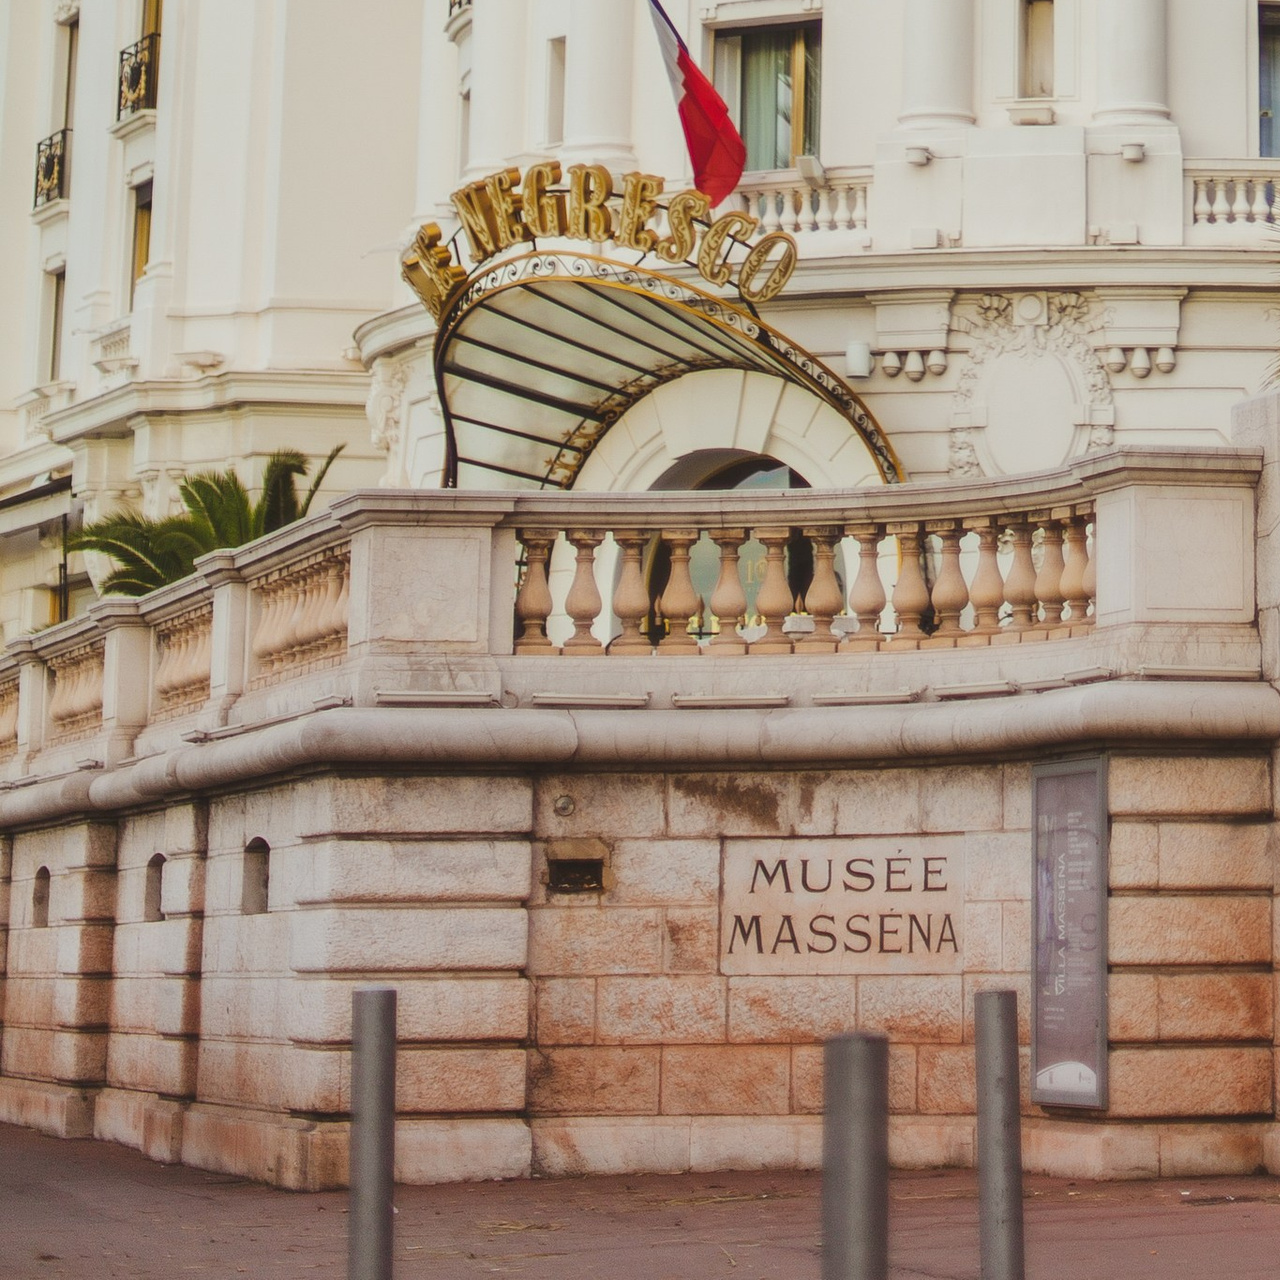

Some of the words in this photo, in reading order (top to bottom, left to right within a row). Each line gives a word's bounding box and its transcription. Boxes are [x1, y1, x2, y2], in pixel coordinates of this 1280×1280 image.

[401, 221, 467, 328] LE
[450, 160, 798, 304] NEGRESCO
[748, 848, 948, 894] MUSÉE
[727, 907, 959, 954] MASSÉNA
